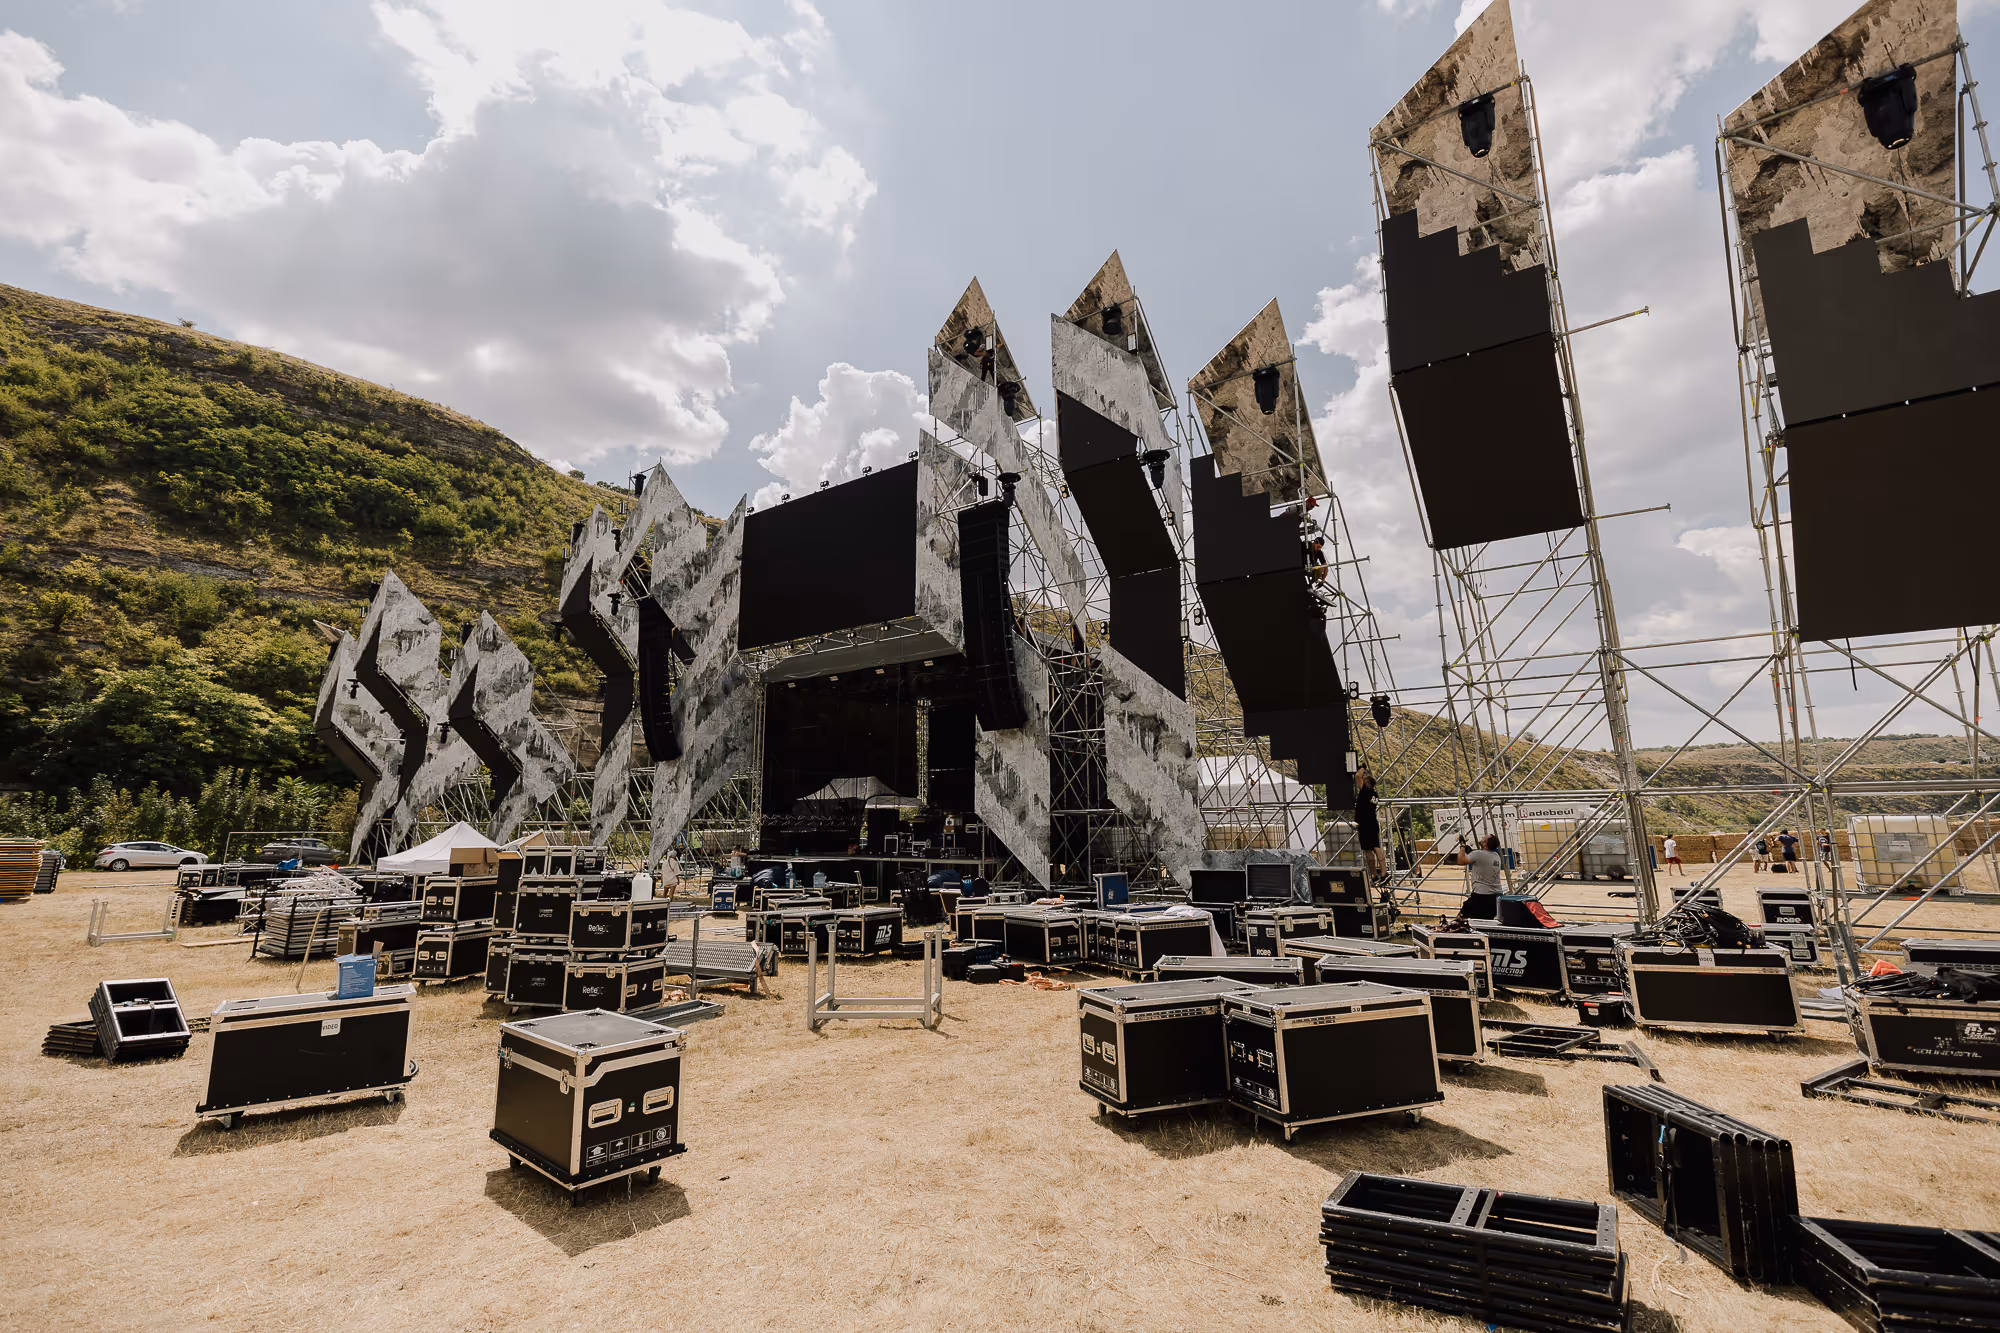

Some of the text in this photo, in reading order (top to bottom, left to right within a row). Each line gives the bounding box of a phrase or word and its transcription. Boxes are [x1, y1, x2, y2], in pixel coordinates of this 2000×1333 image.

[1437, 813, 1481, 822] Monage
[1519, 808, 1574, 818] Radebeul
[1492, 966, 1524, 975] ODUCTION
[322, 1023, 339, 1031] VIDEO
